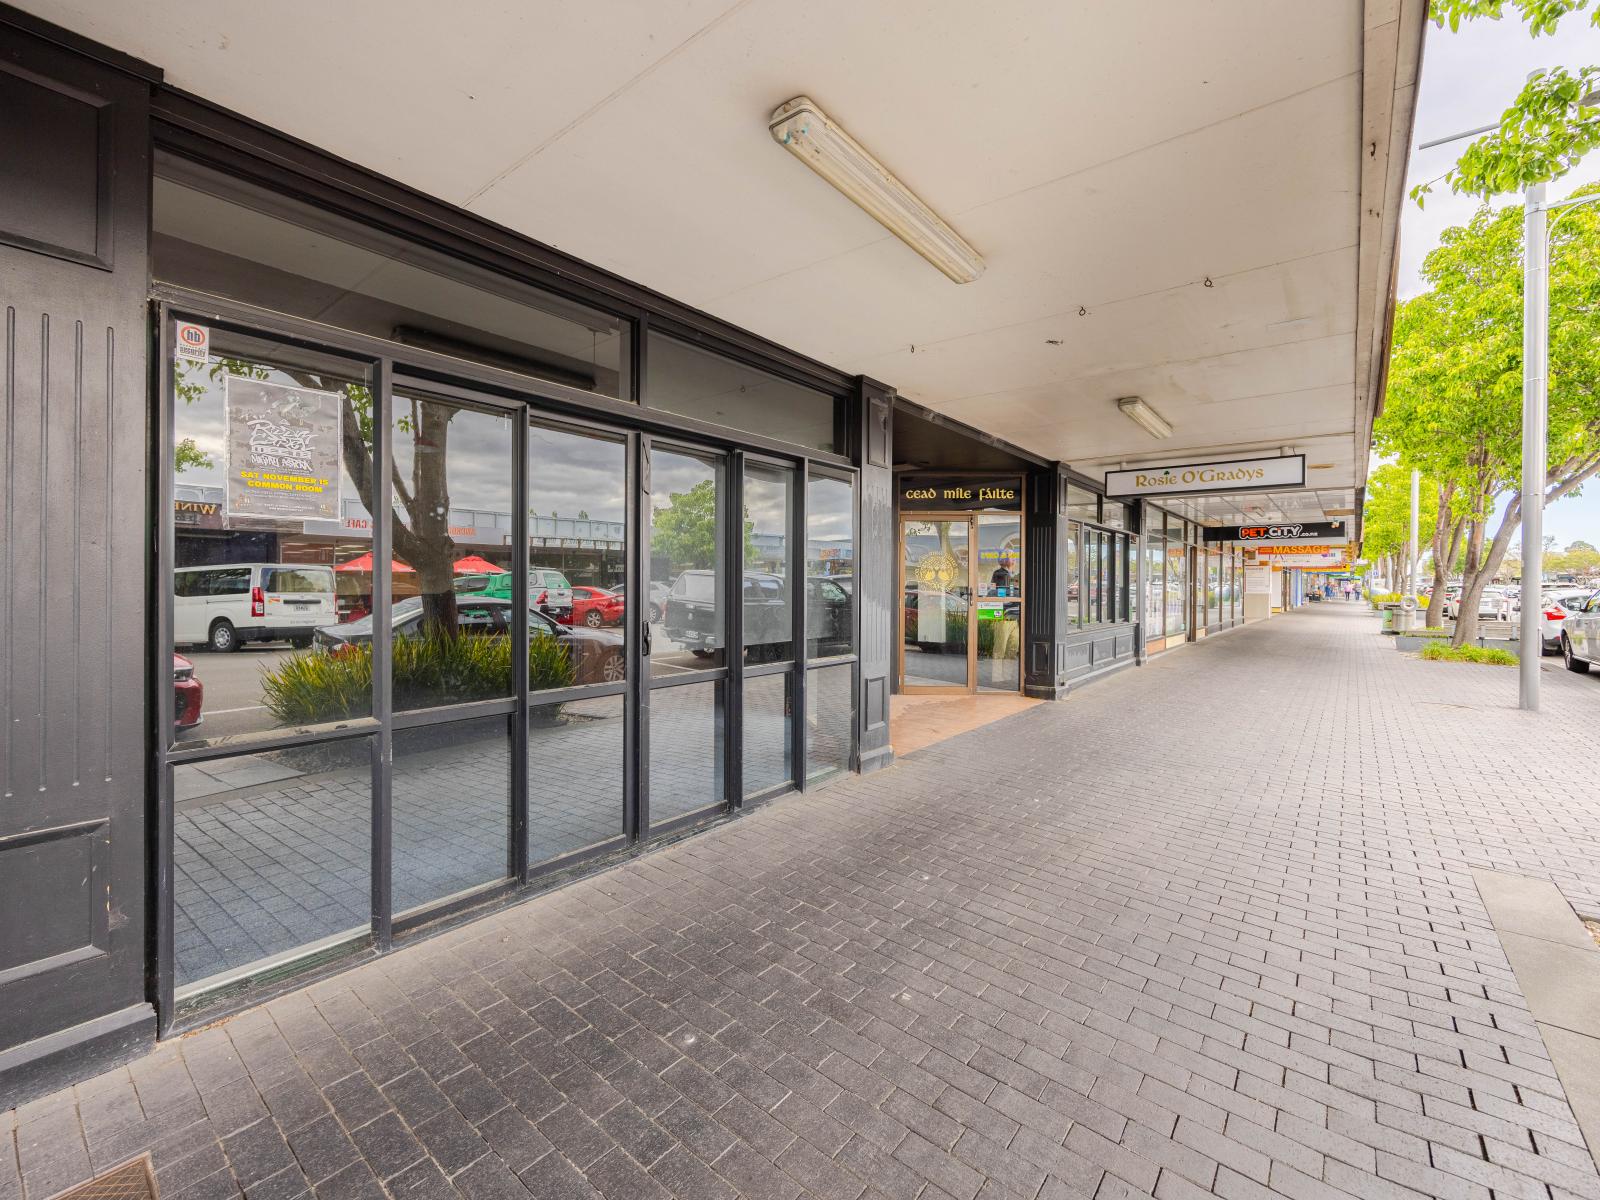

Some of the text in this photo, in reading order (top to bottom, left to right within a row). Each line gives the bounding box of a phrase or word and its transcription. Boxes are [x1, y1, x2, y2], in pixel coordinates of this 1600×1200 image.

[241, 470, 260, 479] SAT
[262, 472, 317, 485] NOVEMBER
[319, 478, 329, 487] 15
[247, 480, 323, 493] COMMON ROOM
[1241, 527, 1268, 538] PET
[1273, 545, 1329, 554] MASSAGE
